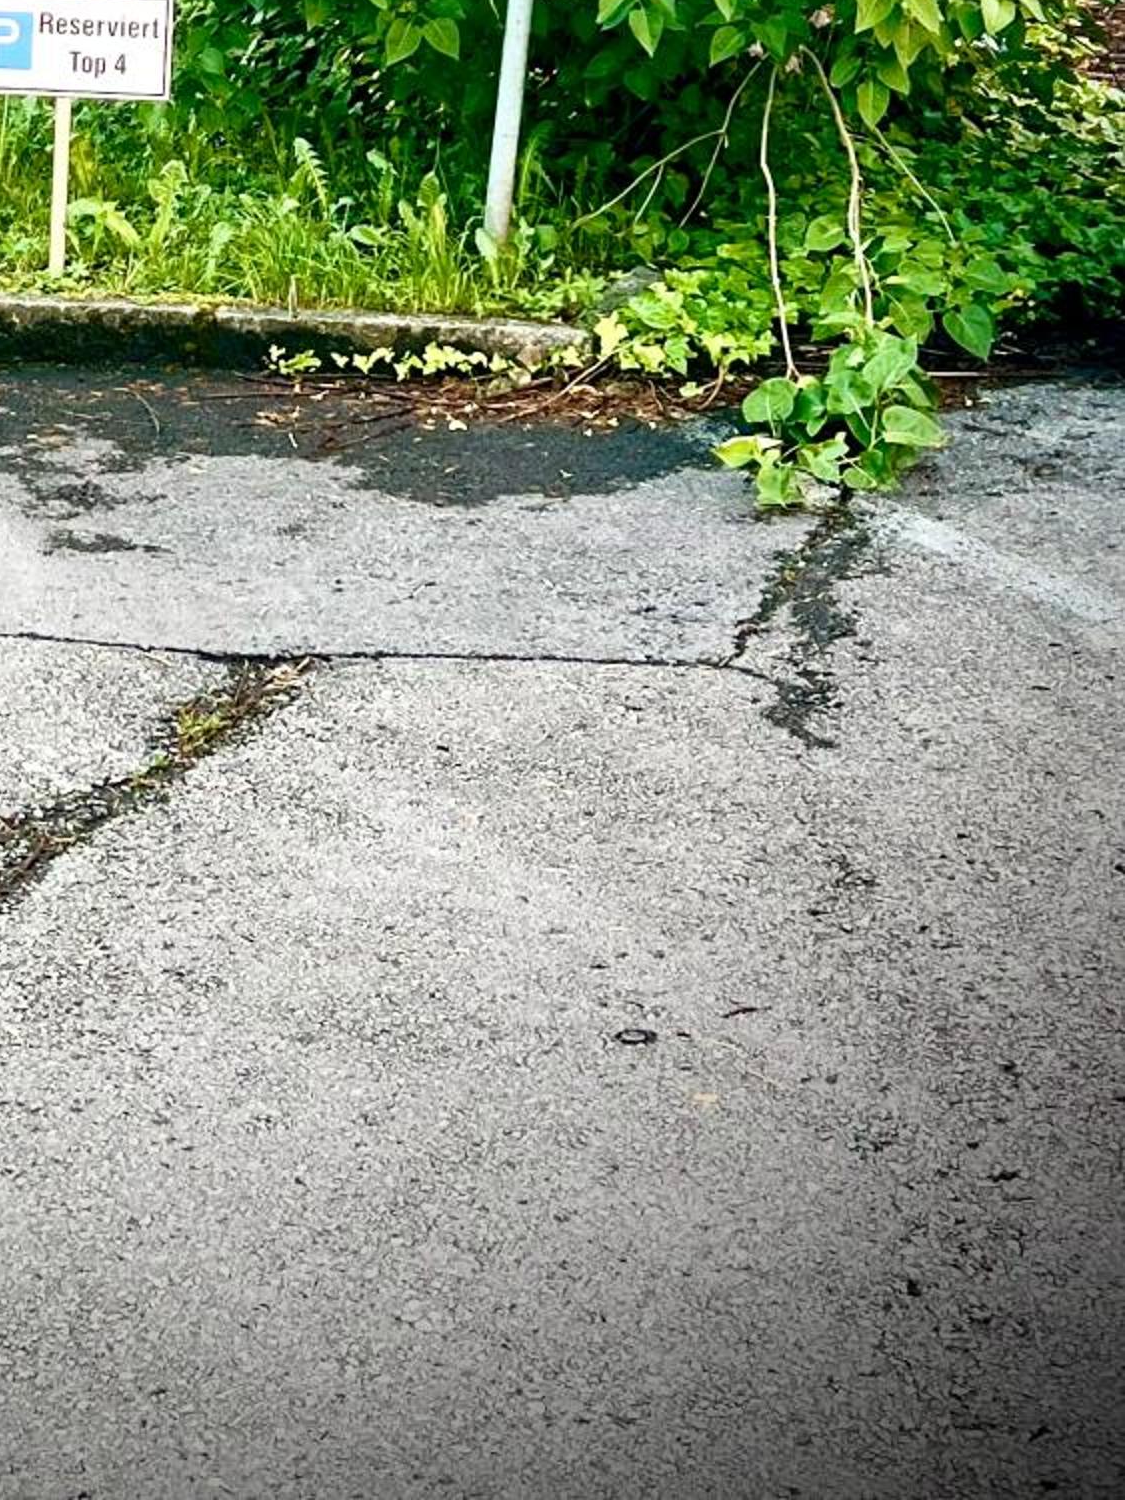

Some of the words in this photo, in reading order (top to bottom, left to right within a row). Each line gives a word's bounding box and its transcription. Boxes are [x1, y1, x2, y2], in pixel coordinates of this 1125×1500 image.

[39, 11, 159, 39] Reserviert
[70, 51, 106, 78] Top
[114, 53, 126, 74] 4
